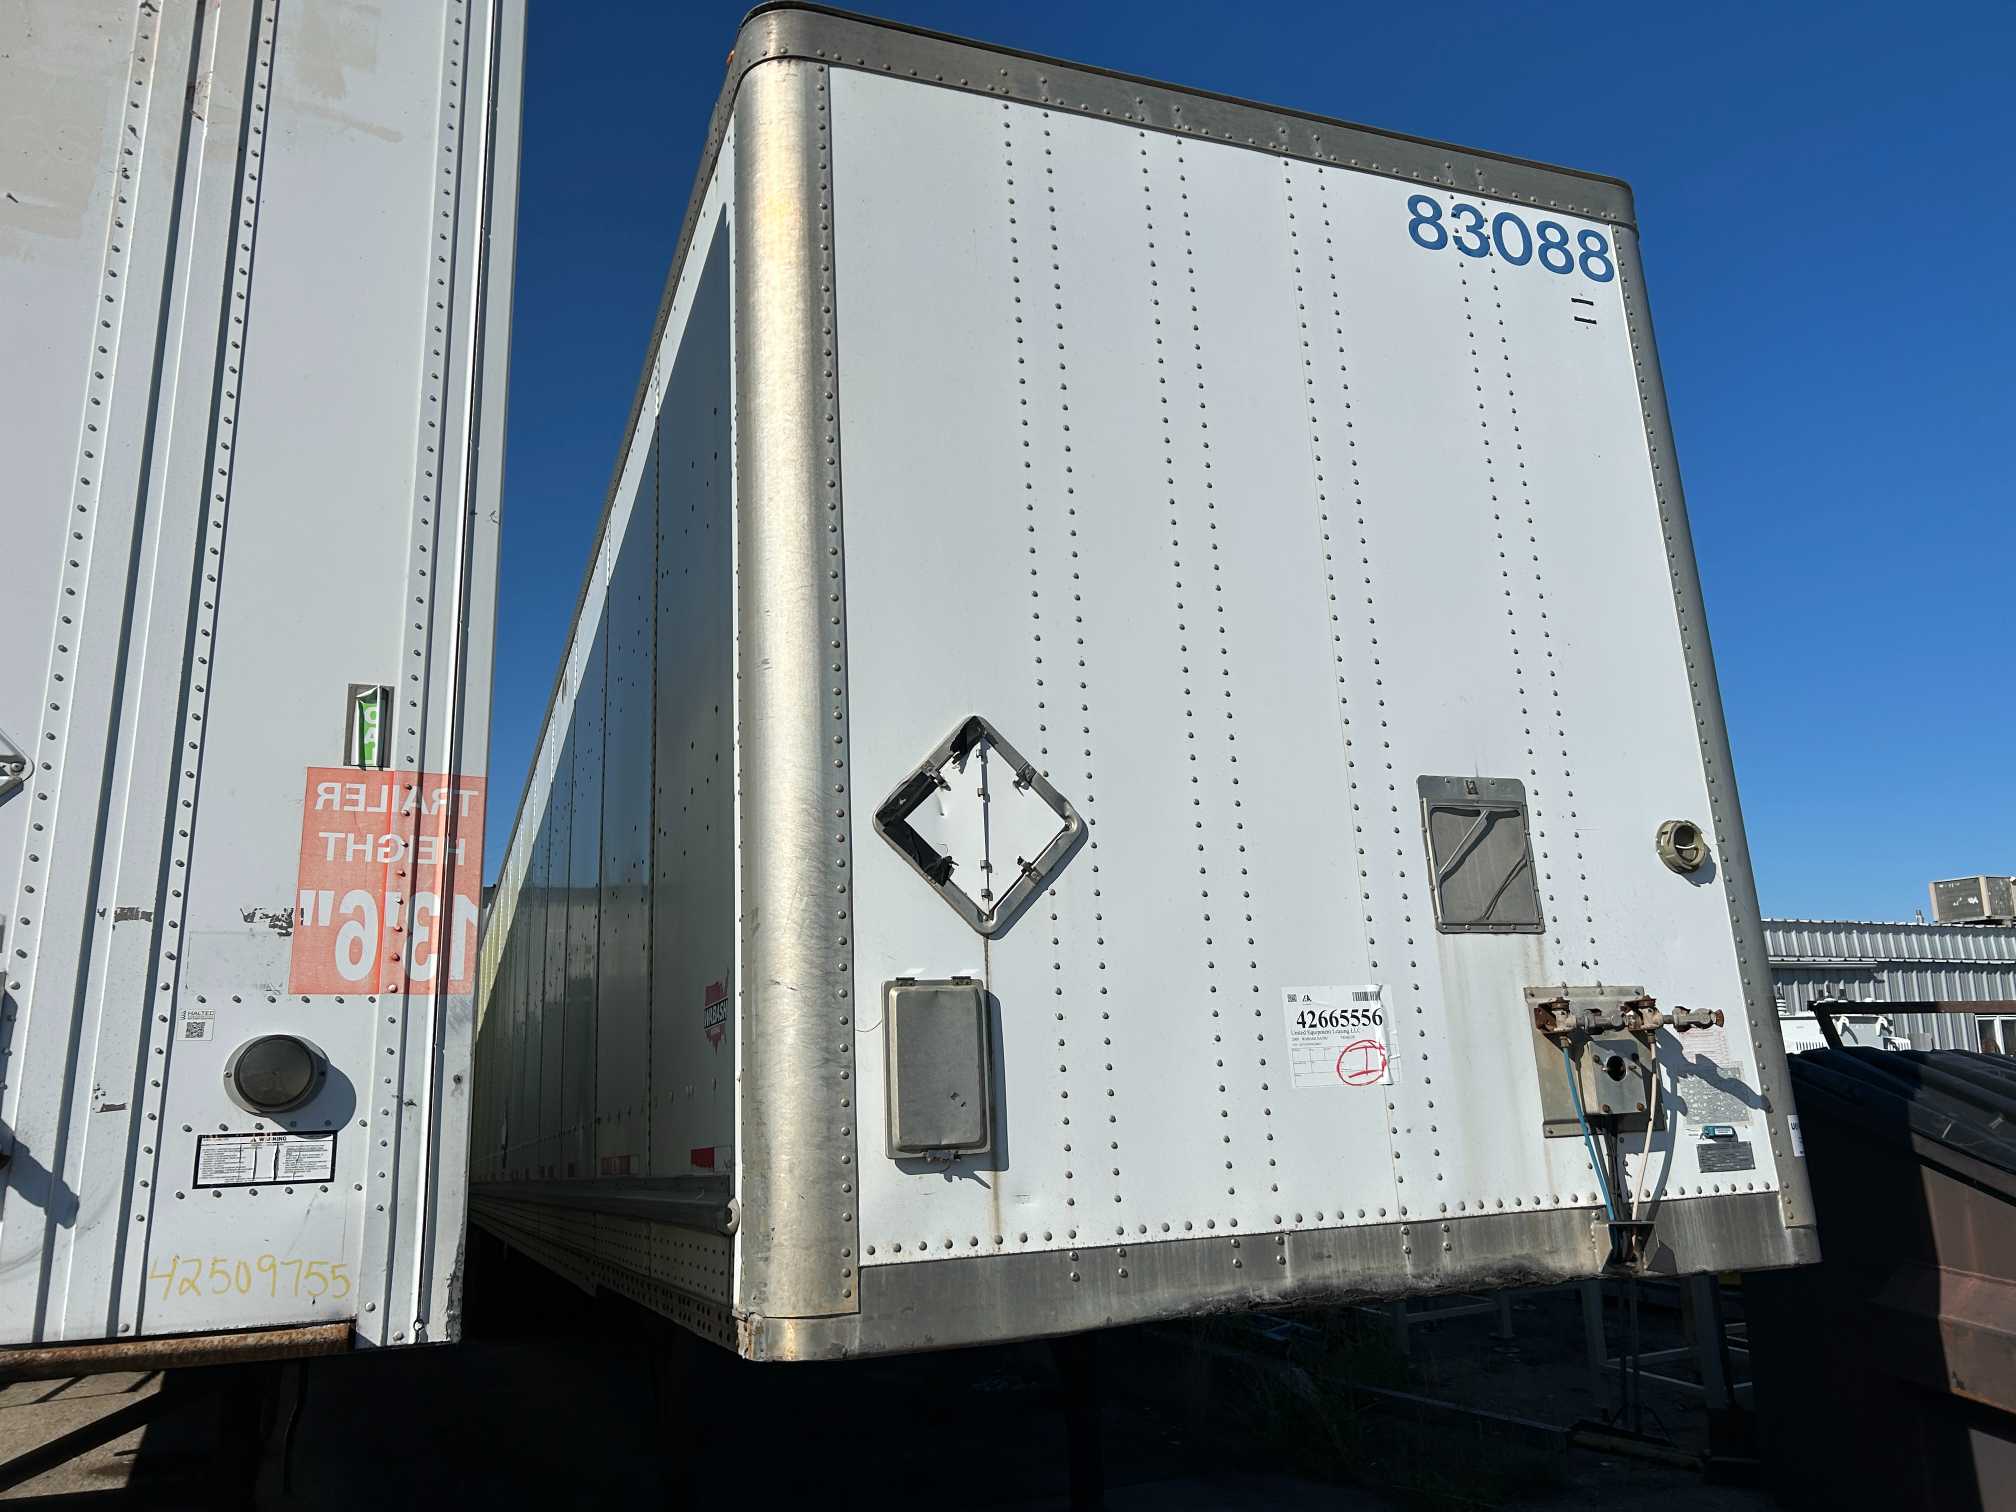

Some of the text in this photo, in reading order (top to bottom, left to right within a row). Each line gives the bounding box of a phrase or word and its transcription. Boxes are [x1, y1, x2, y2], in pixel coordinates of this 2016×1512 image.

[1407, 194, 1615, 283] 83088
[1296, 1008, 1383, 1028] 42665556
[148, 1254, 351, 1300] 42509755
